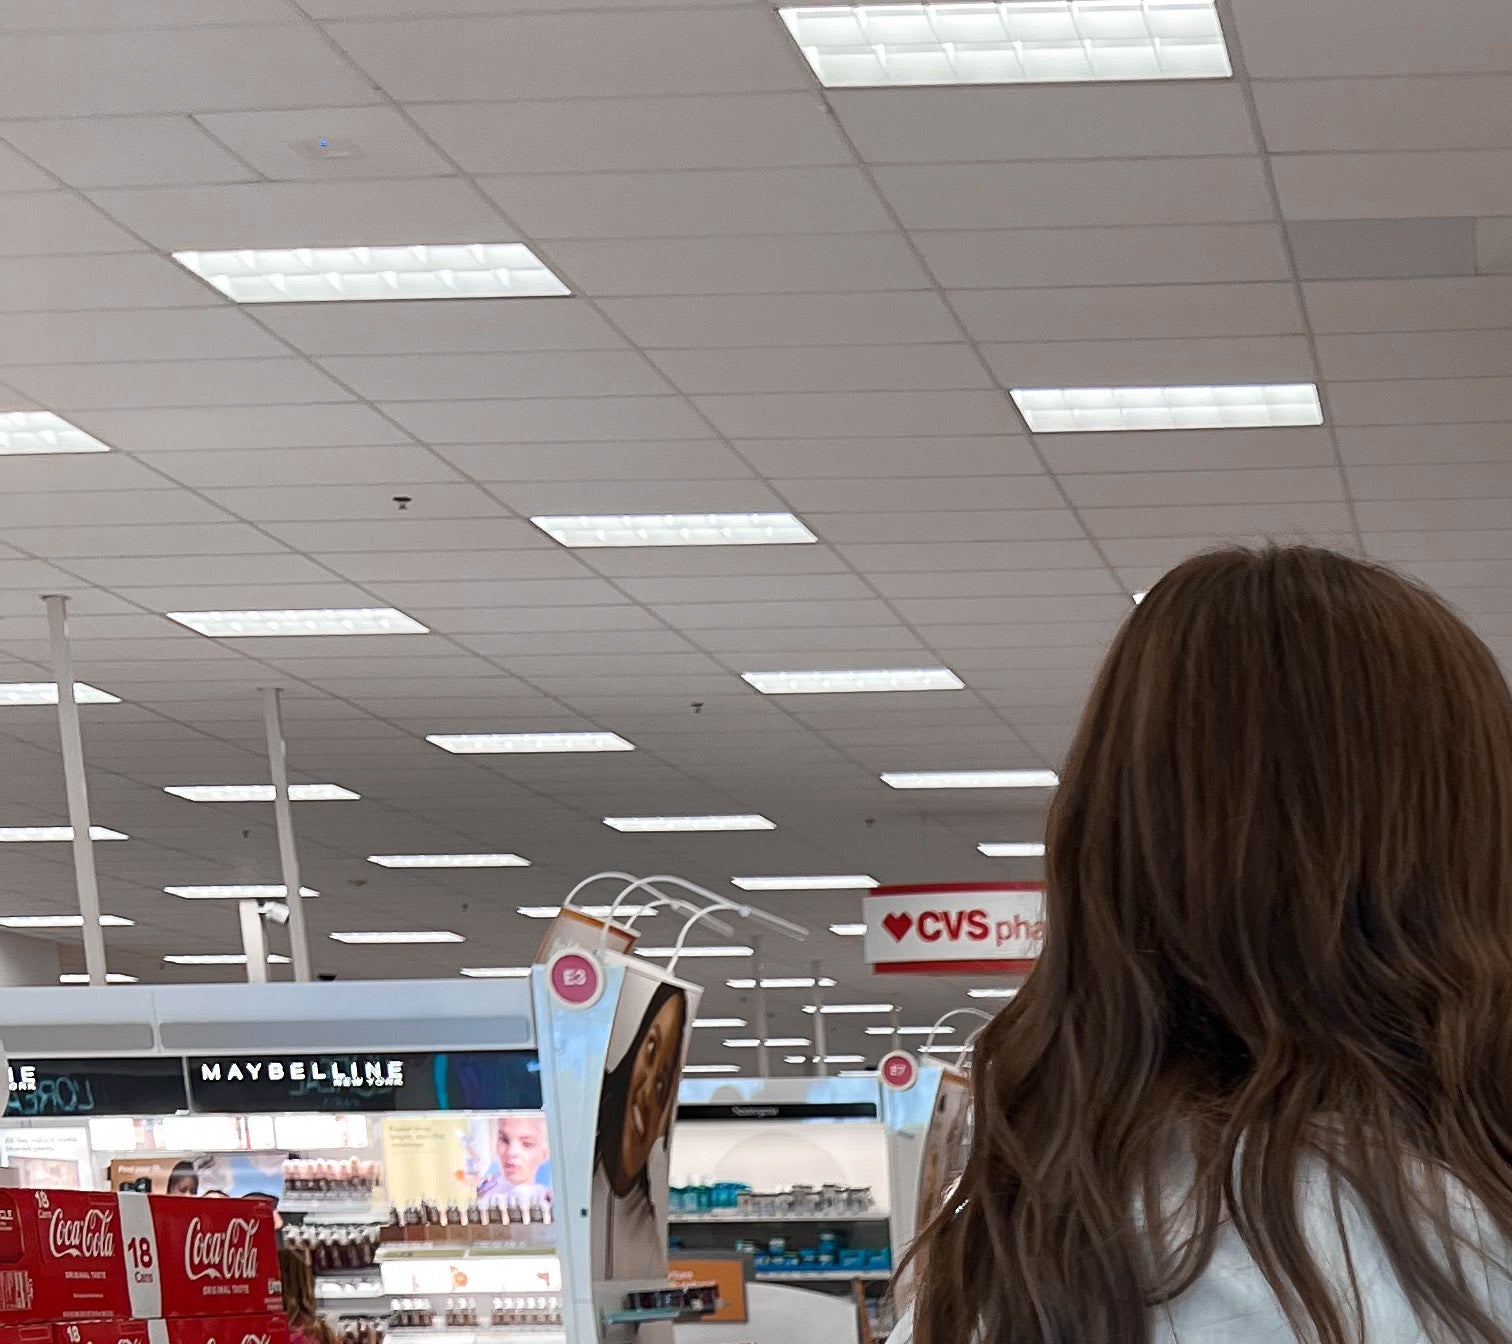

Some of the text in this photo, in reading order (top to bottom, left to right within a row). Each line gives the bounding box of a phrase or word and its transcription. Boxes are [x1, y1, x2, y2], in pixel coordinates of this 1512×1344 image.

[916, 910, 989, 942] CVS
[201, 1060, 404, 1081] MAYBELLINE
[49, 1208, 114, 1258] Coca-Cola
[185, 1217, 259, 1281] Coca-Cola
[128, 1237, 152, 1269] 18
